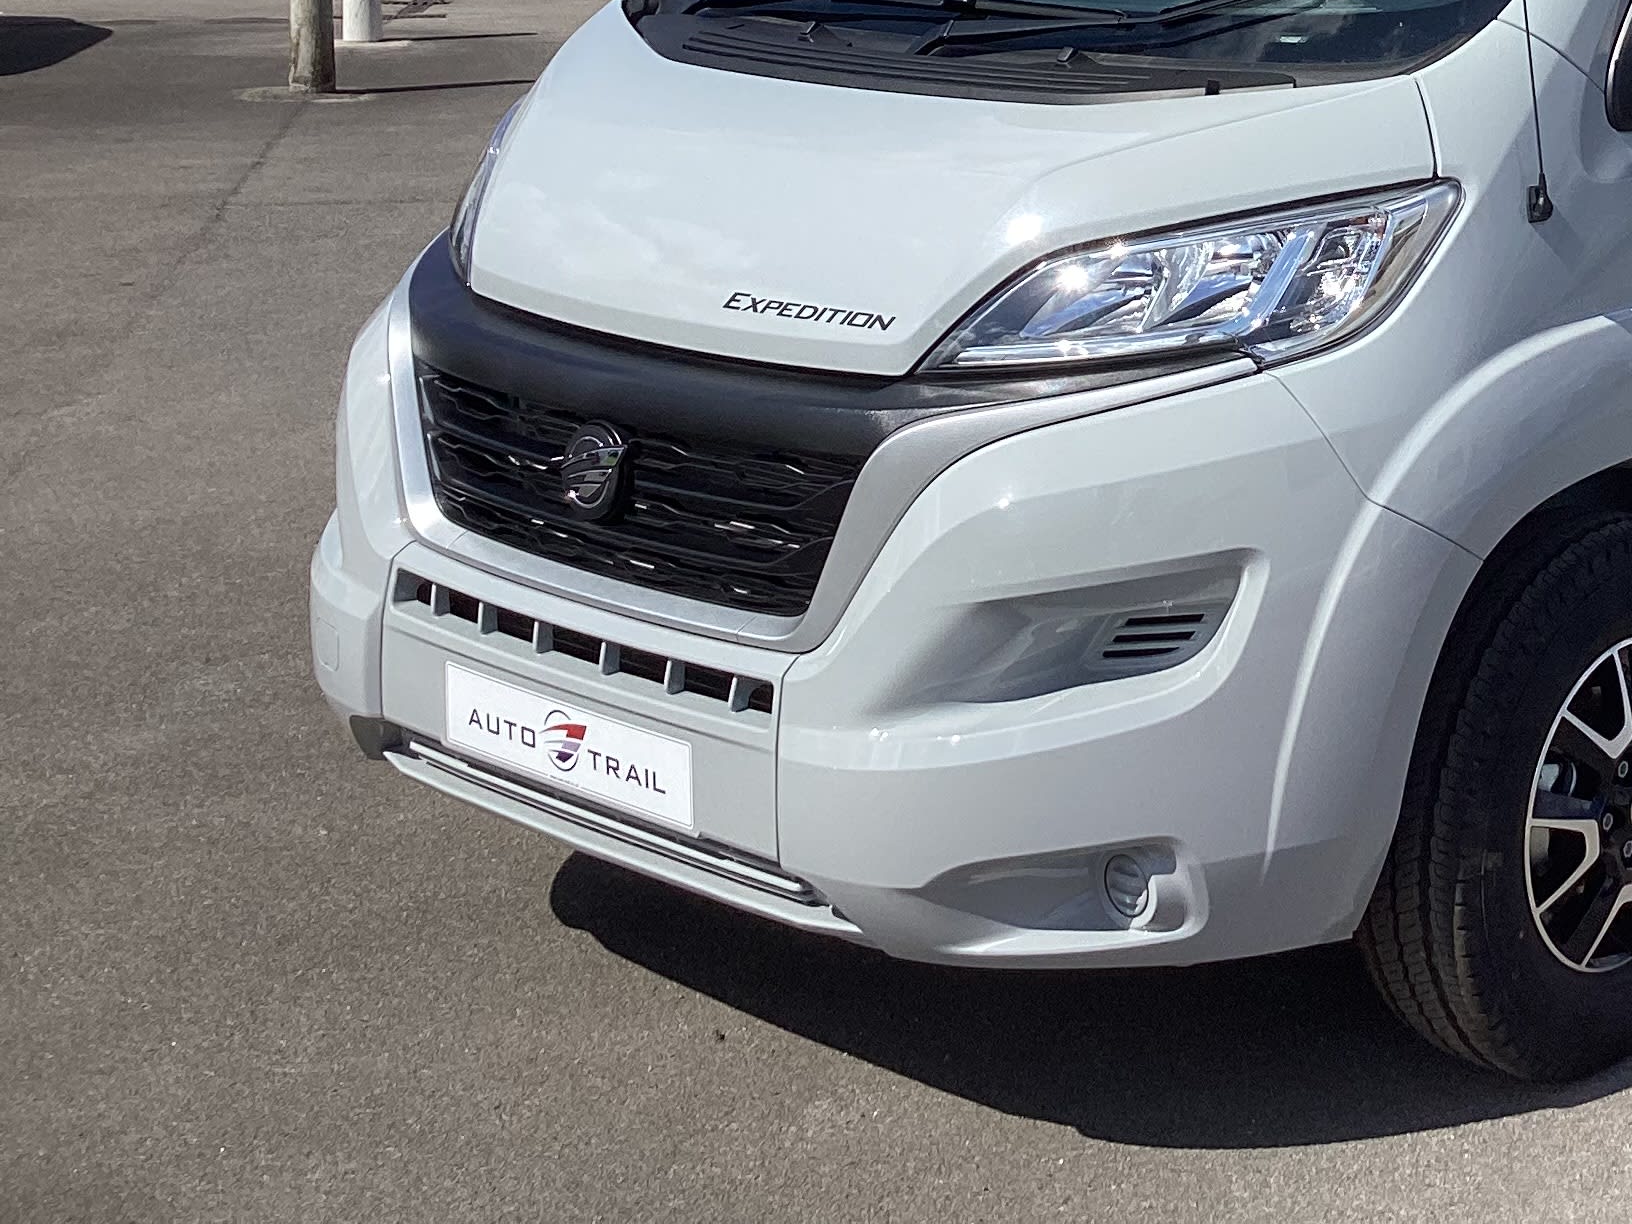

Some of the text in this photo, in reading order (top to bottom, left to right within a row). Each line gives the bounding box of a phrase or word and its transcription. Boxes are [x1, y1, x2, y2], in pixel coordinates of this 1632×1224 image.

[722, 291, 897, 331] EXPEDITION
[468, 708, 667, 795] AUTO TRAIL
